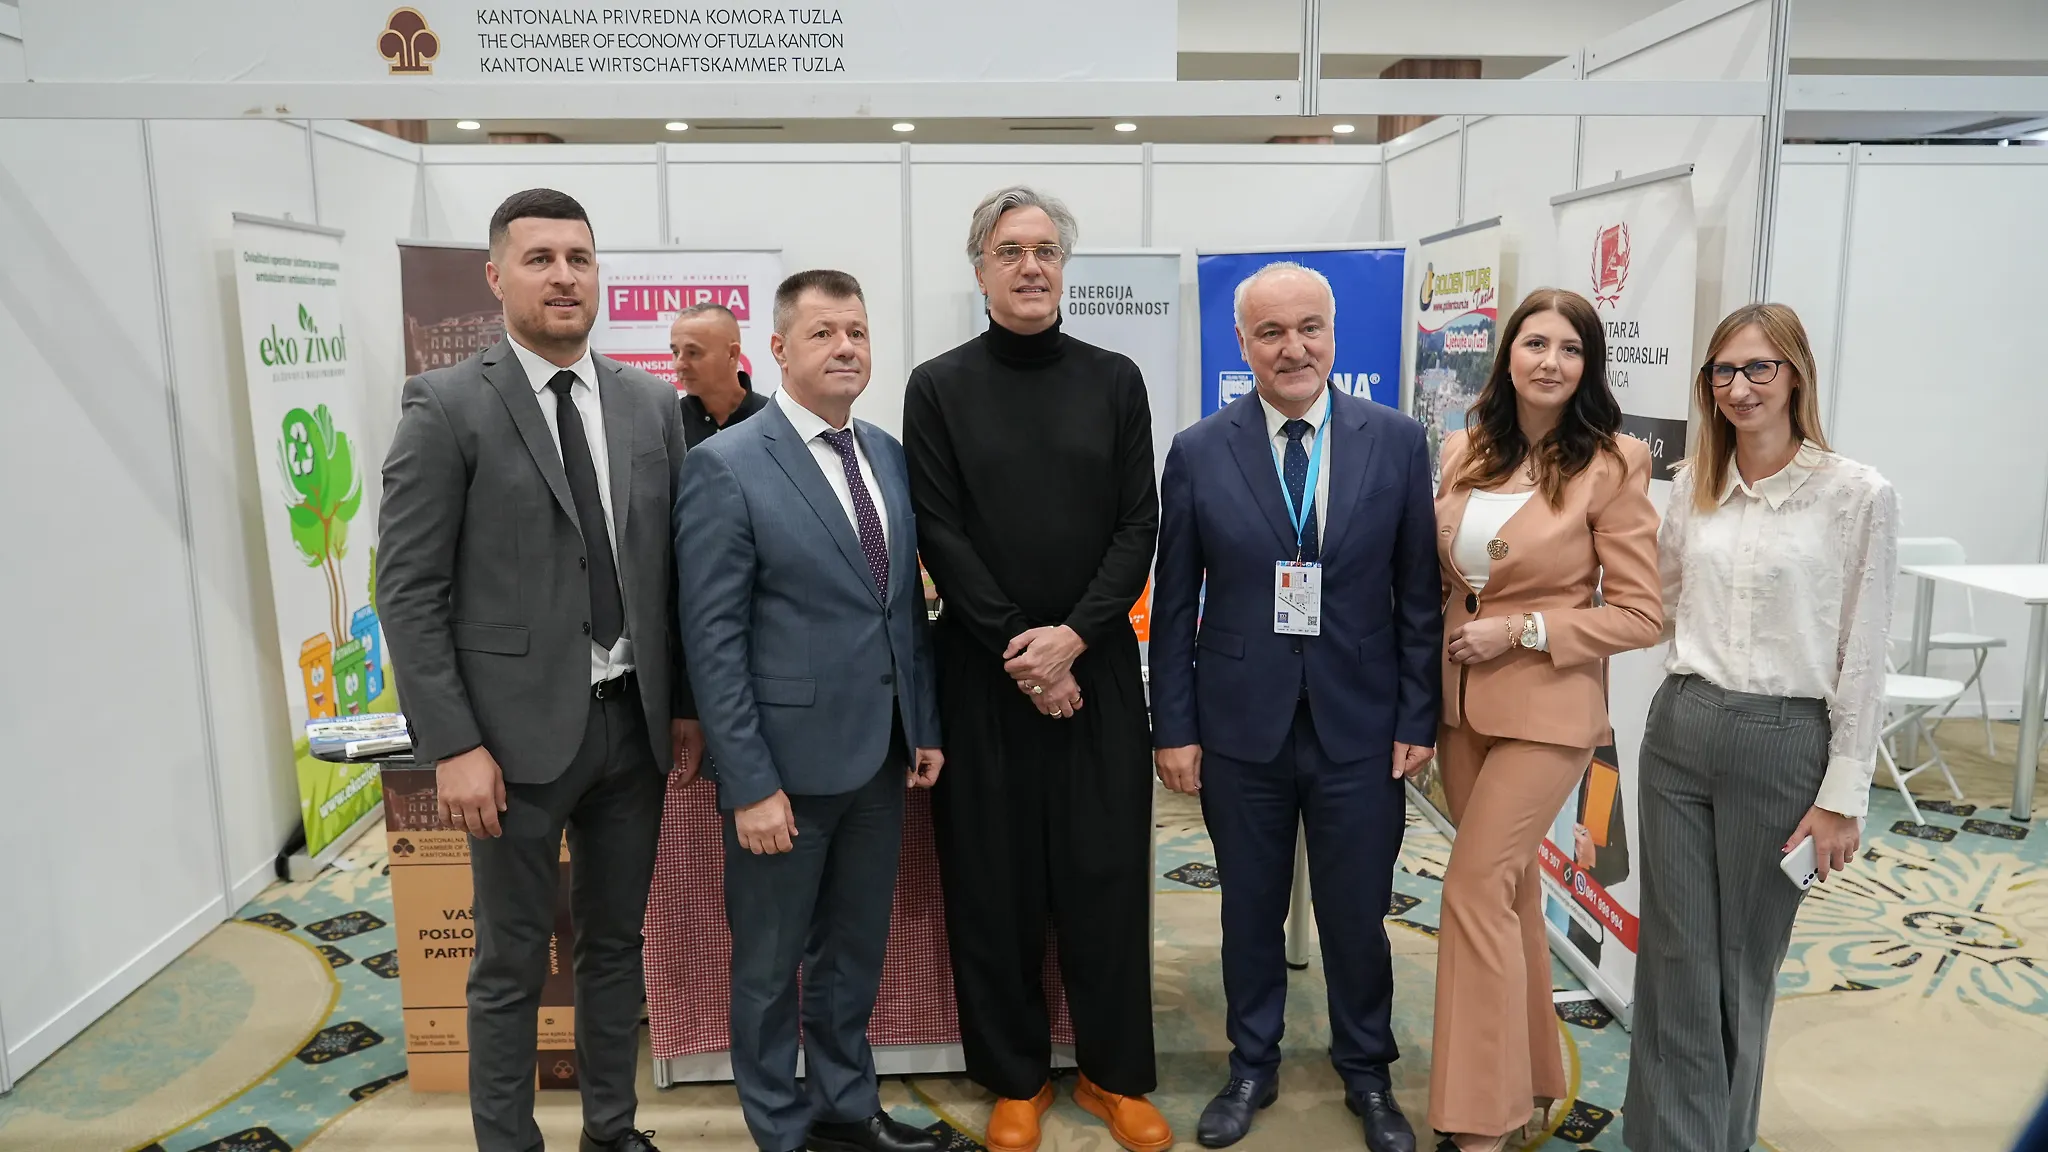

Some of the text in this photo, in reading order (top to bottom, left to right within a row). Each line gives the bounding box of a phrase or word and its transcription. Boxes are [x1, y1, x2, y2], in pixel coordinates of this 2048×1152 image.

[477, 9, 843, 25] KANTONALNA PRIVREDNA KOMORA TUZLA
[478, 33, 843, 48] THE CHAMBER OF ECONOMY OF TUZLA KANTON
[480, 57, 845, 72] KANTONALE WIRTSCHAFTSKAMMER TUZLA
[1434, 267, 1491, 296] GOLDEN TOURS
[1069, 286, 1133, 301] ENERGIJA
[1069, 302, 1170, 315] ODGOVORNOST
[1604, 322, 1640, 338] NTAR ZA
[259, 324, 298, 366] eko
[1616, 346, 1669, 365] ODRASLIH
[419, 928, 474, 940] POSLO
